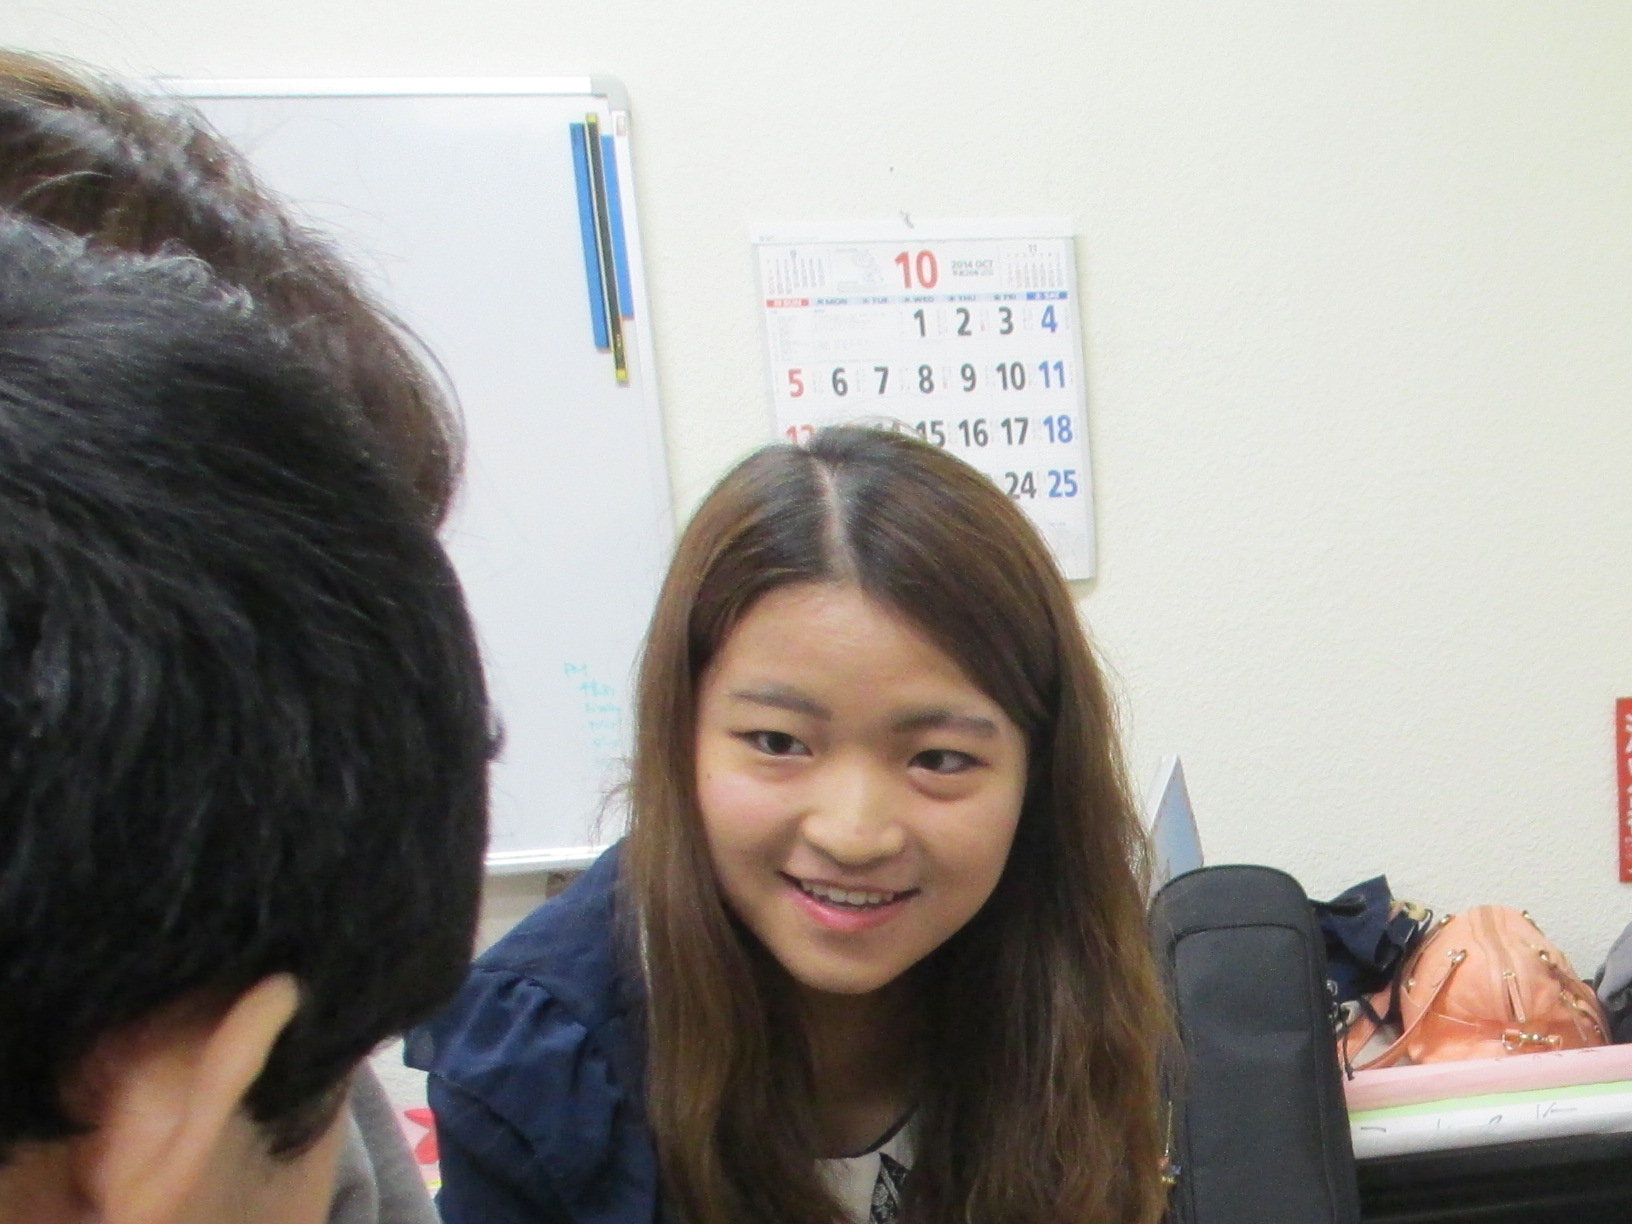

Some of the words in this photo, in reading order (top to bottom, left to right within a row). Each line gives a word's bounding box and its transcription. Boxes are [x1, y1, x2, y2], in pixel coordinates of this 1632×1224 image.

[894, 250, 938, 289] 10
[952, 260, 974, 269] 2014
[975, 260, 993, 269] OCT
[913, 309, 926, 337] 1
[956, 307, 972, 336] 2
[998, 306, 1014, 335] 3
[1041, 305, 1058, 333] 4
[787, 369, 805, 397] 5
[832, 368, 848, 396] 6
[874, 367, 890, 395] 7
[918, 365, 934, 394] 8
[960, 363, 977, 392] 9
[996, 362, 1026, 391] 10
[1038, 360, 1067, 389] 11
[916, 420, 946, 448] 15
[958, 418, 989, 447] 16
[1000, 417, 1030, 446] 17
[1043, 415, 1074, 444] 18
[1005, 472, 1037, 499] 24
[1048, 470, 1079, 498] 25
